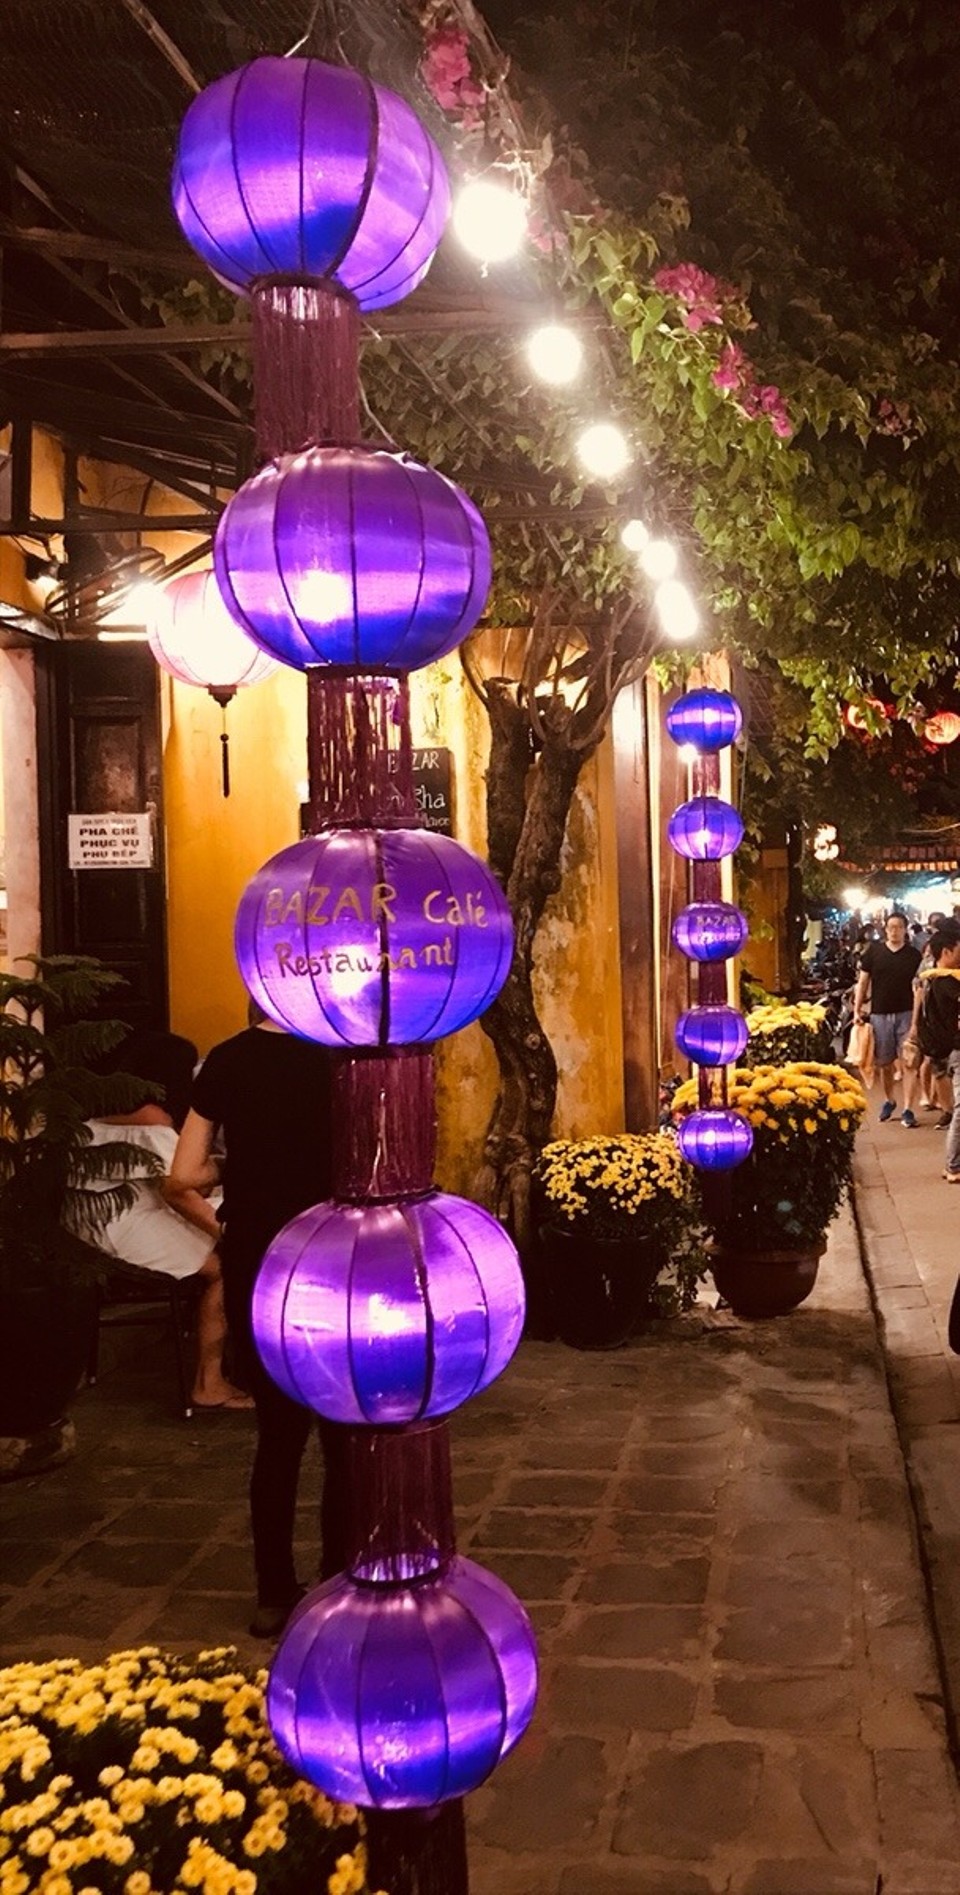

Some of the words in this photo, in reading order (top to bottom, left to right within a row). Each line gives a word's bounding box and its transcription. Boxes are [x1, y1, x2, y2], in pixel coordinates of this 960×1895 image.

[387, 751, 440, 774] BZAR
[79, 828, 107, 836] PHA
[264, 883, 397, 928] BAZAR
[274, 936, 454, 978] Restaurant
